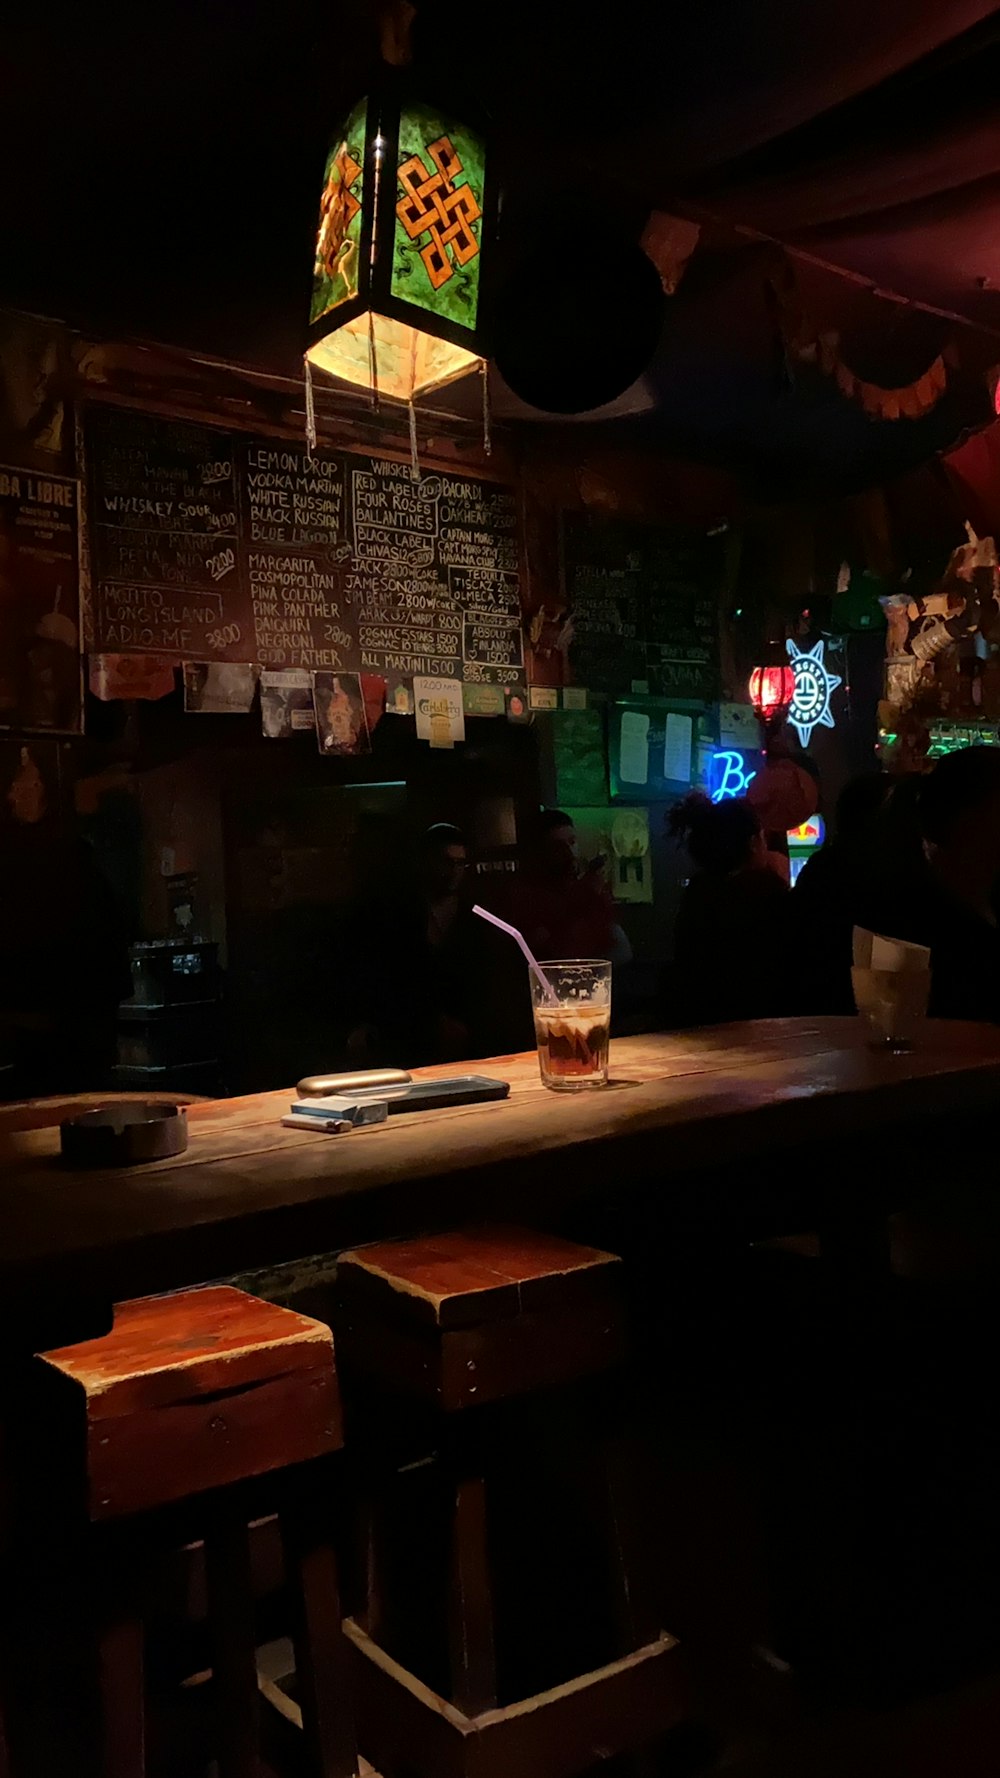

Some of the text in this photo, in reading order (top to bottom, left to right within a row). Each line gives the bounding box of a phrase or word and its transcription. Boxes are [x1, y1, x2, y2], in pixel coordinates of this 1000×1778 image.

[247, 449, 338, 478] LEMON DROP
[27, 478, 74, 508] LIBRE
[247, 472, 343, 497] VODKA MARTINI
[355, 473, 377, 490] RED
[381, 480, 418, 499] LABEL
[442, 477, 482, 500] BACARDI
[104, 496, 212, 517] WHISKEY SOUR
[246, 485, 341, 513] WHITE RUSSIAN
[356, 490, 432, 515] FOUR ROSES
[250, 505, 340, 529] BLACK RUSSIAN
[356, 508, 434, 530] BALLANTINES
[250, 522, 338, 546] BLUE LAGOON
[357, 526, 430, 549] BLACK LABEL
[440, 527, 473, 542] CAPTAIN
[357, 542, 399, 560] CHIVAS
[437, 540, 460, 554] CAPT
[205, 548, 236, 577] 2200
[248, 553, 318, 573] MARGARITA
[351, 560, 382, 574] JACK
[382, 563, 409, 577] 2800
[439, 552, 477, 566] HAVANA
[476, 557, 495, 568] CLUB
[248, 570, 335, 590] COSMOPOLITAN
[344, 574, 407, 593] JAMESON
[406, 580, 429, 594] 2800
[466, 569, 506, 583] TEQUILA
[104, 584, 164, 607] MOJITO
[281, 587, 326, 604] COLADA
[366, 591, 393, 606] BEAM
[396, 593, 427, 609] 2800
[454, 591, 496, 603] OLMECA
[105, 605, 216, 625] LONG ISLAND
[253, 600, 341, 618] PINK PANTHER
[254, 616, 311, 632] DAIQUIRI
[438, 614, 461, 630] 800
[205, 623, 241, 648] 3800
[255, 632, 315, 649] NEGRONI
[323, 624, 353, 648] 2800
[359, 627, 401, 641] COGNAC
[436, 633, 459, 646] 1500
[472, 626, 513, 639] ABSOLUT
[358, 636, 400, 650] COGNAC
[472, 639, 518, 654] FINLANDIA
[256, 648, 343, 667] GOD FATHER
[361, 651, 455, 675] ALL MARTINI 1500
[486, 651, 511, 665] 1500
[420, 679, 442, 690] 1200
[496, 669, 520, 683] 3500
